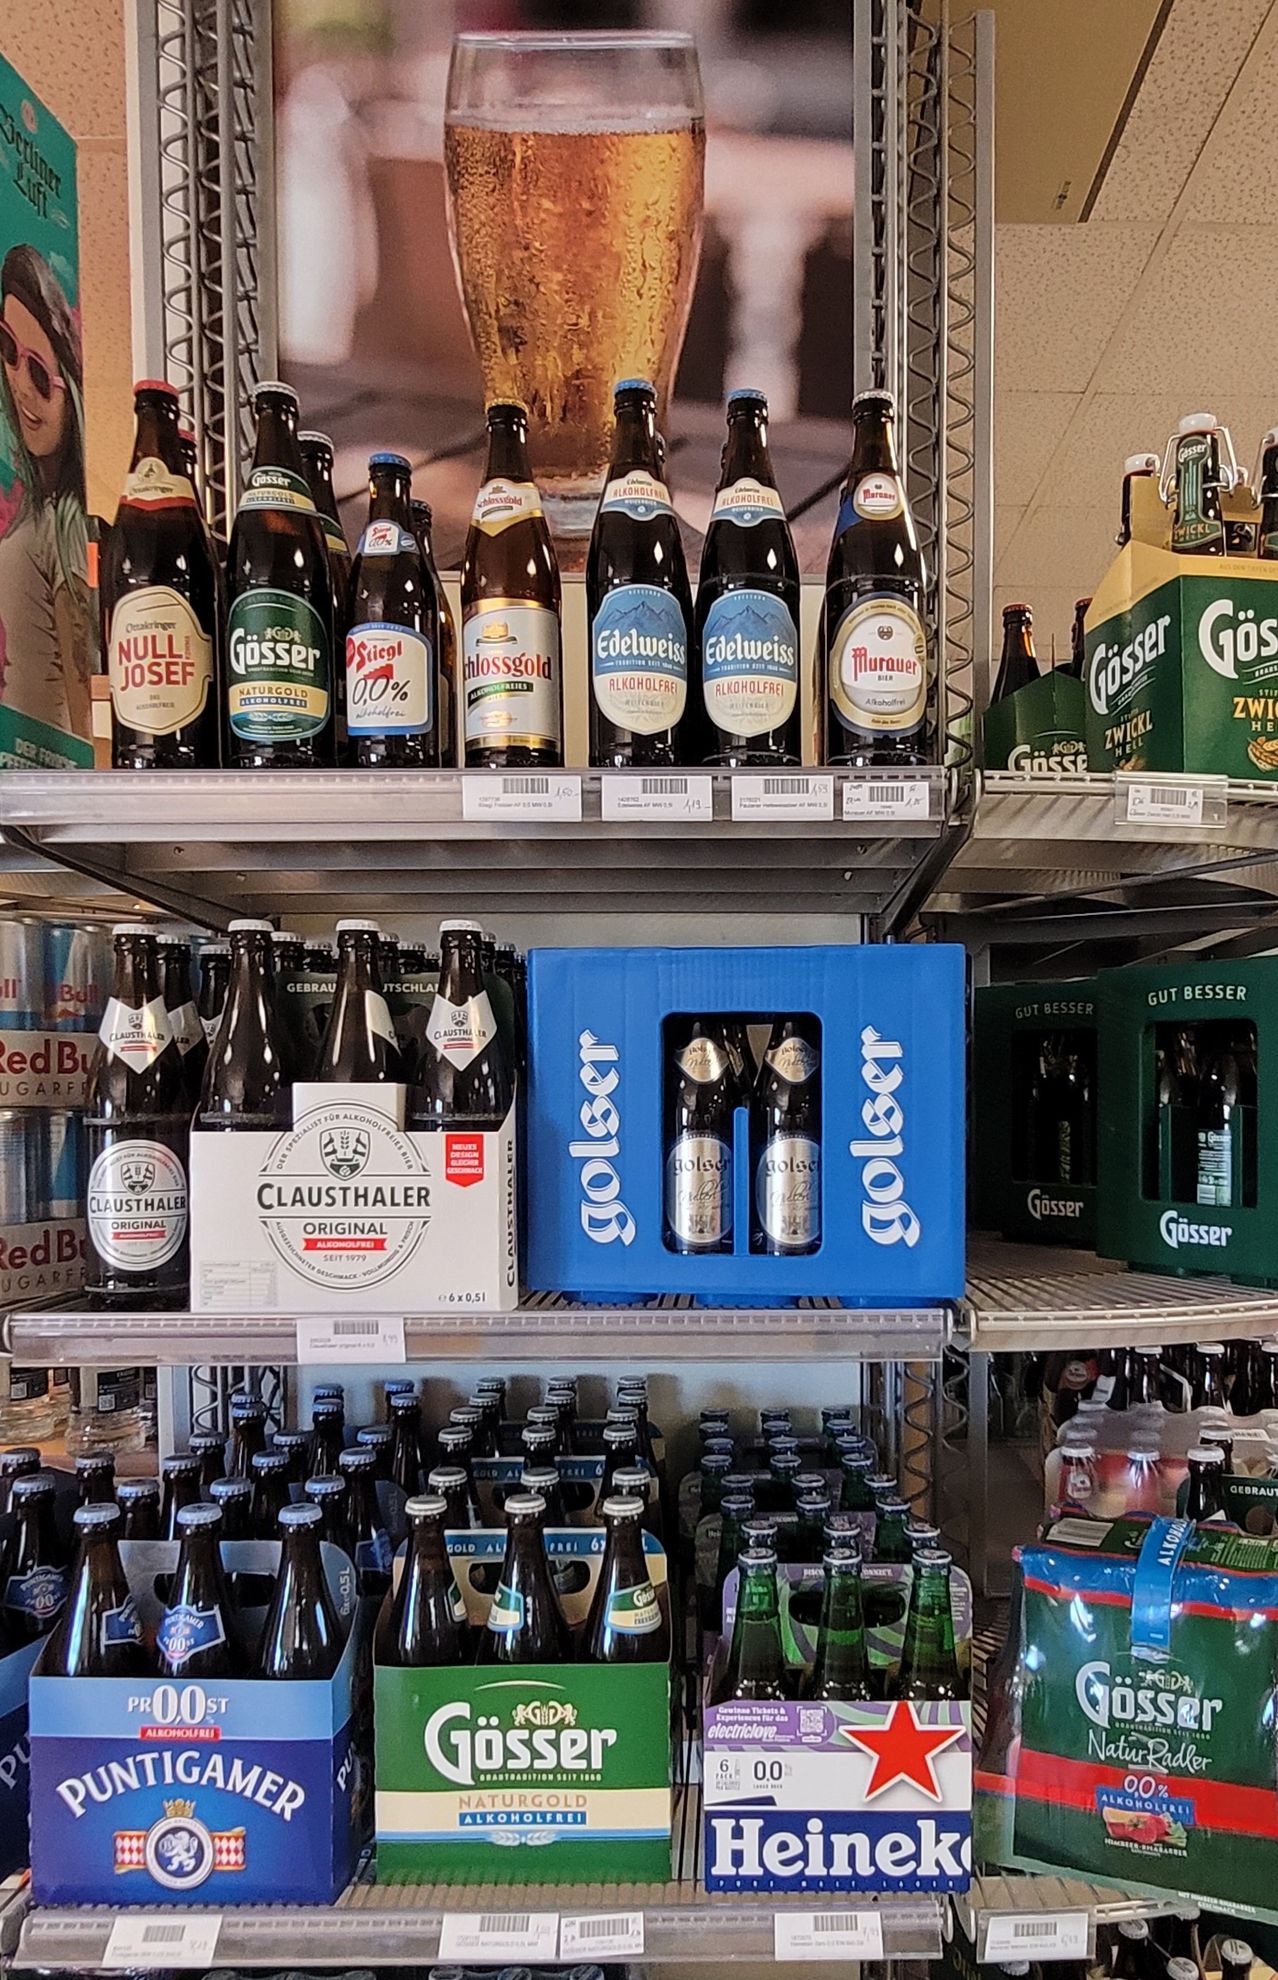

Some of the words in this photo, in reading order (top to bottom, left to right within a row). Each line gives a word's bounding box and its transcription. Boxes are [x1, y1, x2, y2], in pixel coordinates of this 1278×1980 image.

[613, 487, 665, 499] ALKOHOLFREI
[722, 494, 774, 506] ALKOHOLFREI
[118, 633, 183, 666] NULL
[230, 628, 321, 675] Gösser
[356, 640, 402, 673] Stiegl
[597, 628, 685, 665] Edelweiss
[705, 633, 794, 666] Edelweiss
[465, 652, 552, 681] hlossgold
[851, 646, 917, 681] Murauer
[1090, 614, 1172, 716] Gösser
[120, 660, 195, 691] JOSEF
[609, 678, 678, 694] ALKOHOLFREI
[239, 687, 308, 698] NATURGOLD
[353, 675, 411, 706] 0,0%
[715, 681, 784, 697] ALKOHOLFREI
[241, 698, 306, 706] ALKOHOLFREI
[865, 698, 906, 706] Alkoholfrei
[1104, 709, 1153, 750] ZWICKL
[1115, 736, 1143, 758] HELL
[286, 982, 337, 994] GEBRAU
[1148, 987, 1179, 1006] GUT
[1184, 984, 1247, 1001] BESSER
[1015, 1005, 1039, 1019] GUT
[1044, 1002, 1094, 1015] BESSER
[434, 1028, 487, 1041] CLAUSTHAER
[58, 1040, 89, 1074] Bu
[324, 1113, 340, 1122] FÜR
[568, 1028, 637, 1248] golser
[850, 1024, 922, 1248] golser
[89, 1196, 186, 1213] CLAUSTHALER
[257, 1182, 431, 1210] CLAUSTHALER
[1027, 1189, 1084, 1221] Gösser
[111, 1220, 166, 1230] ORIGINAL
[507, 1140, 516, 1288] CLAUSTHALER
[303, 1222, 388, 1235] ORIGINAL
[1159, 1209, 1233, 1249] Gösser
[316, 1241, 374, 1249] ALKOHOLFREI
[323, 1254, 342, 1262] SEIT
[346, 1254, 366, 1262] 1979
[449, 1293, 456, 1302] 6
[1075, 1660, 1223, 1730] Gösser
[145, 1728, 214, 1738] ALKOHOLFREI
[707, 1722, 778, 1740] electriclove
[424, 1701, 617, 1786] Gösser
[719, 1758, 729, 1773] 6
[753, 1760, 783, 1782] 0.0
[56, 1749, 306, 1823] PUNTIGAMER
[458, 1793, 588, 1810] NATURGOLD
[1100, 1793, 1190, 1815] ALKOHOLFREI
[463, 1812, 583, 1825] ALKOHOLFREI
[711, 1817, 972, 1878] Heinek
